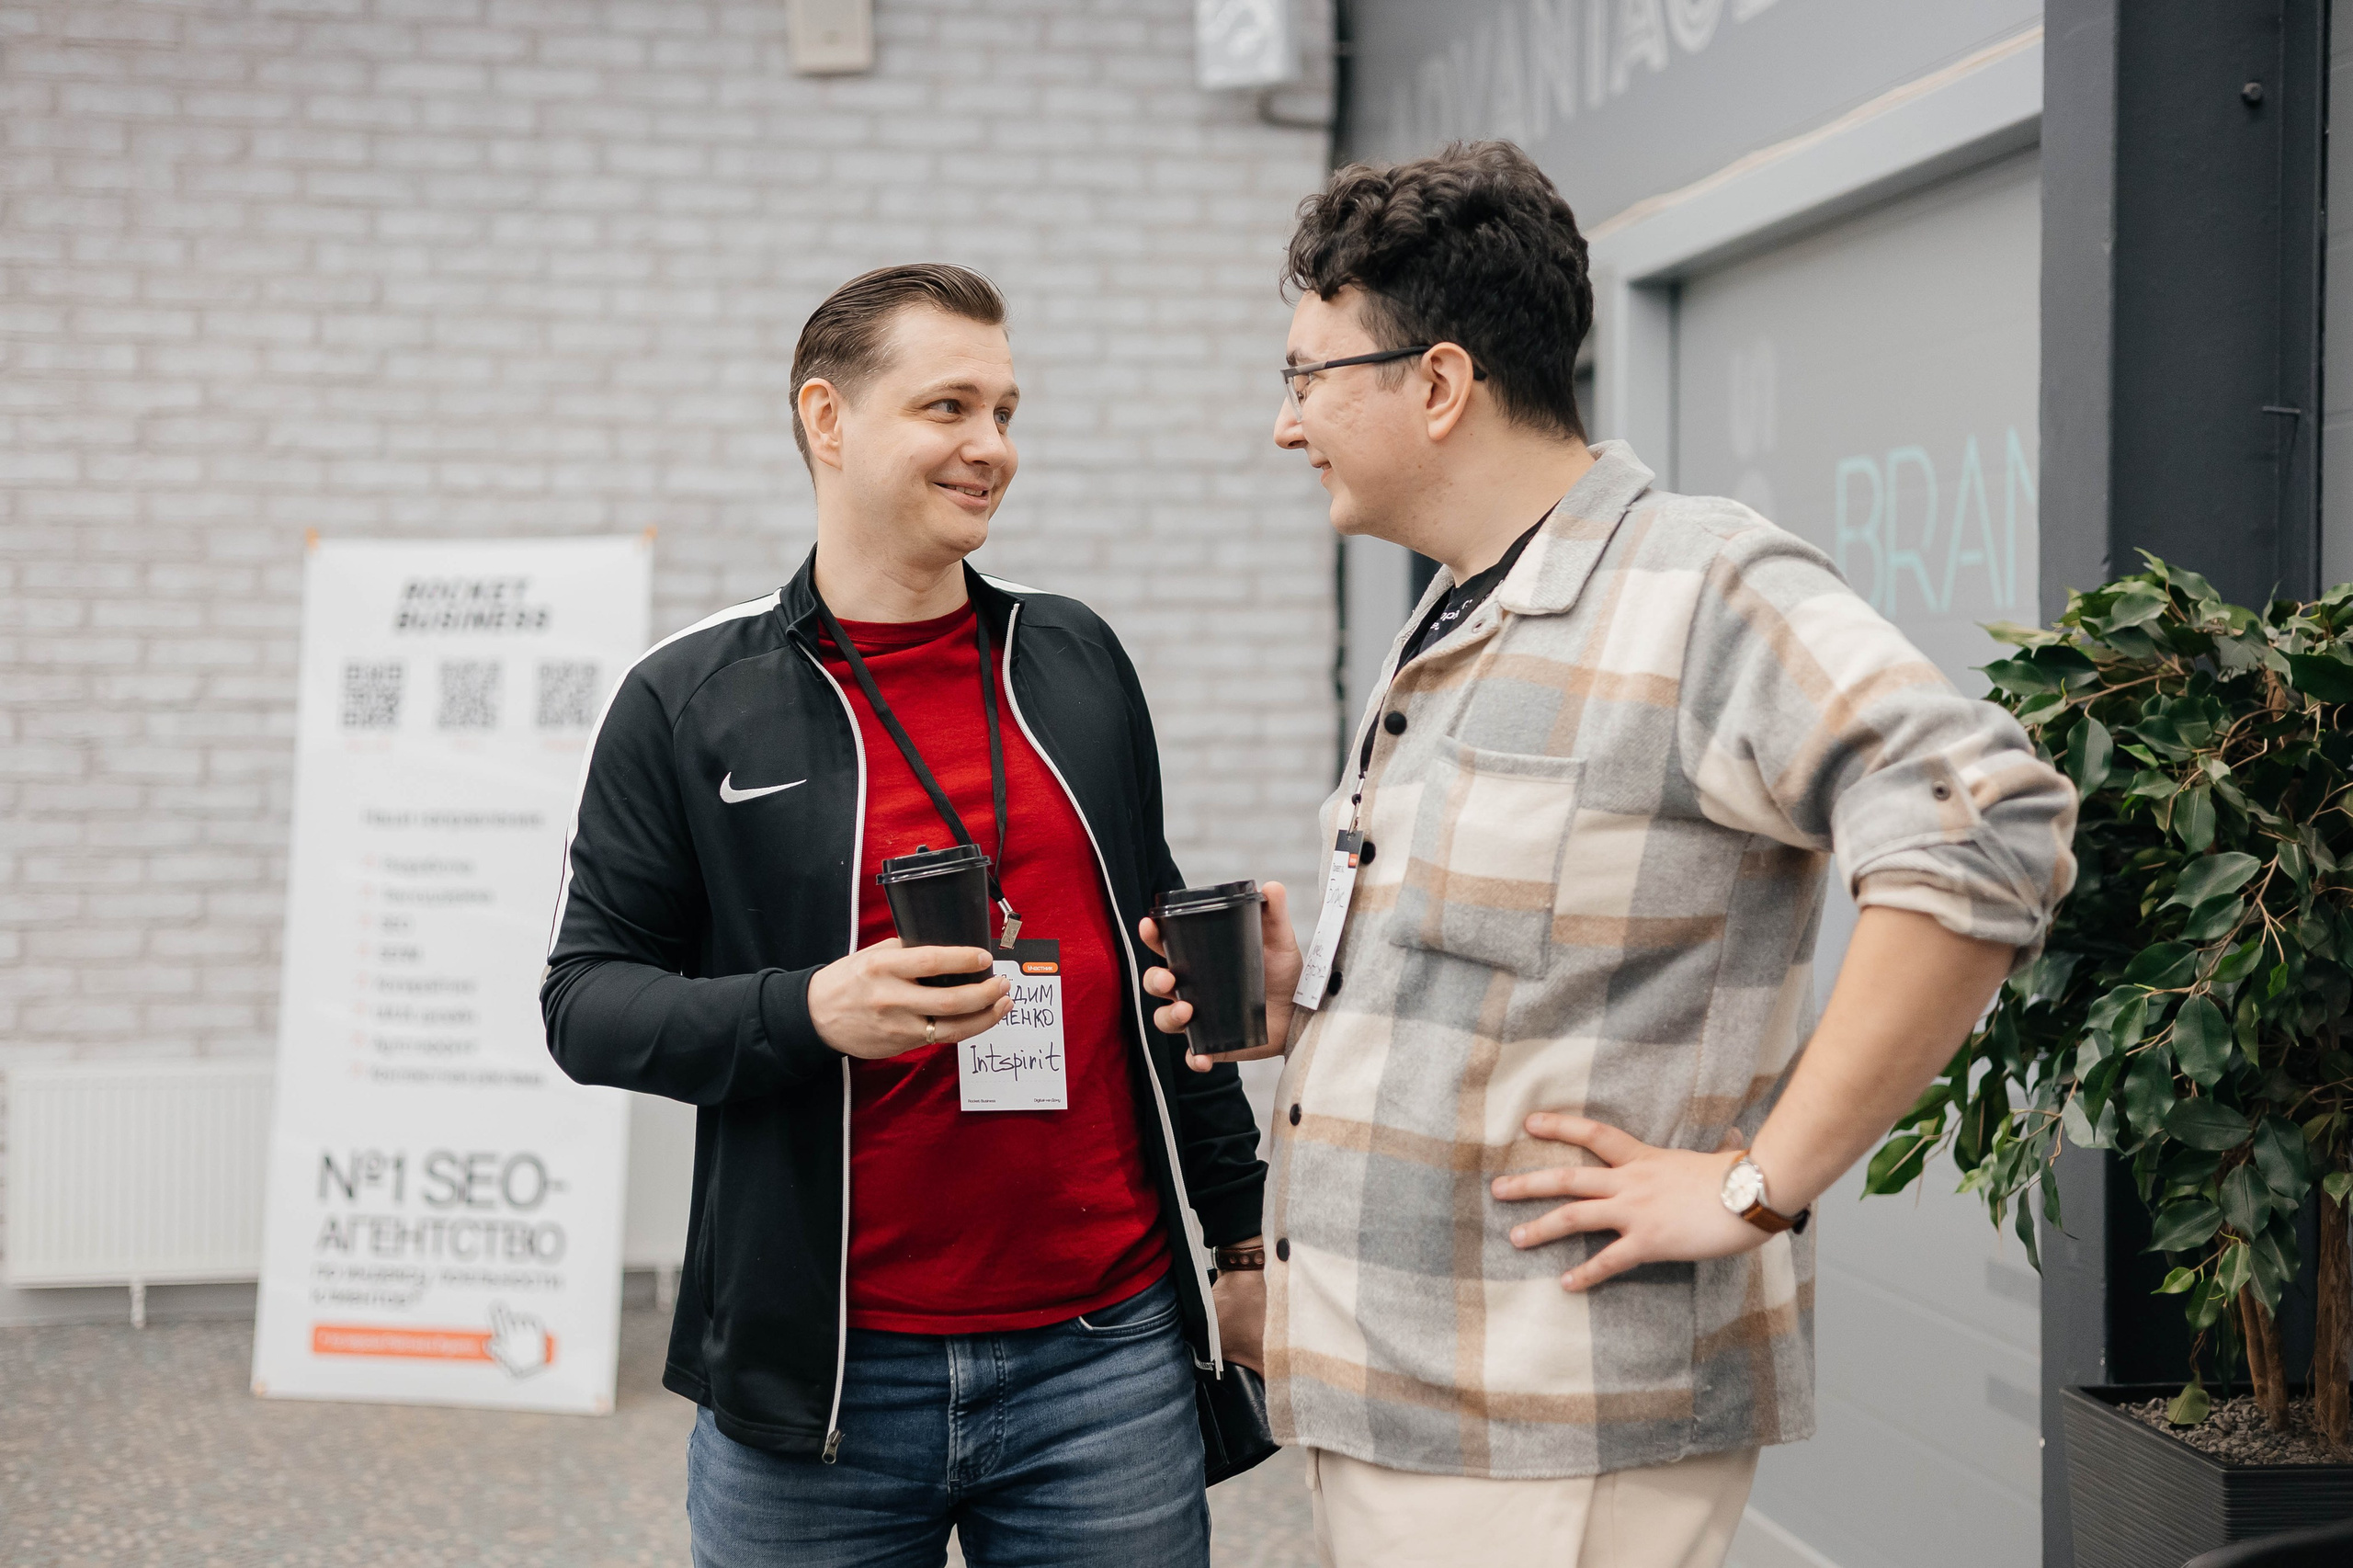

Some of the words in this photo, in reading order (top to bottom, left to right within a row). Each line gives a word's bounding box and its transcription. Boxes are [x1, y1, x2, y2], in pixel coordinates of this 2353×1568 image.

[1006, 983, 1053, 1006] ДИМ
[971, 1042, 1062, 1082] Intspirit
[423, 1152, 569, 1210] SEO-
[317, 1217, 566, 1263] АГЕНТСТВО
